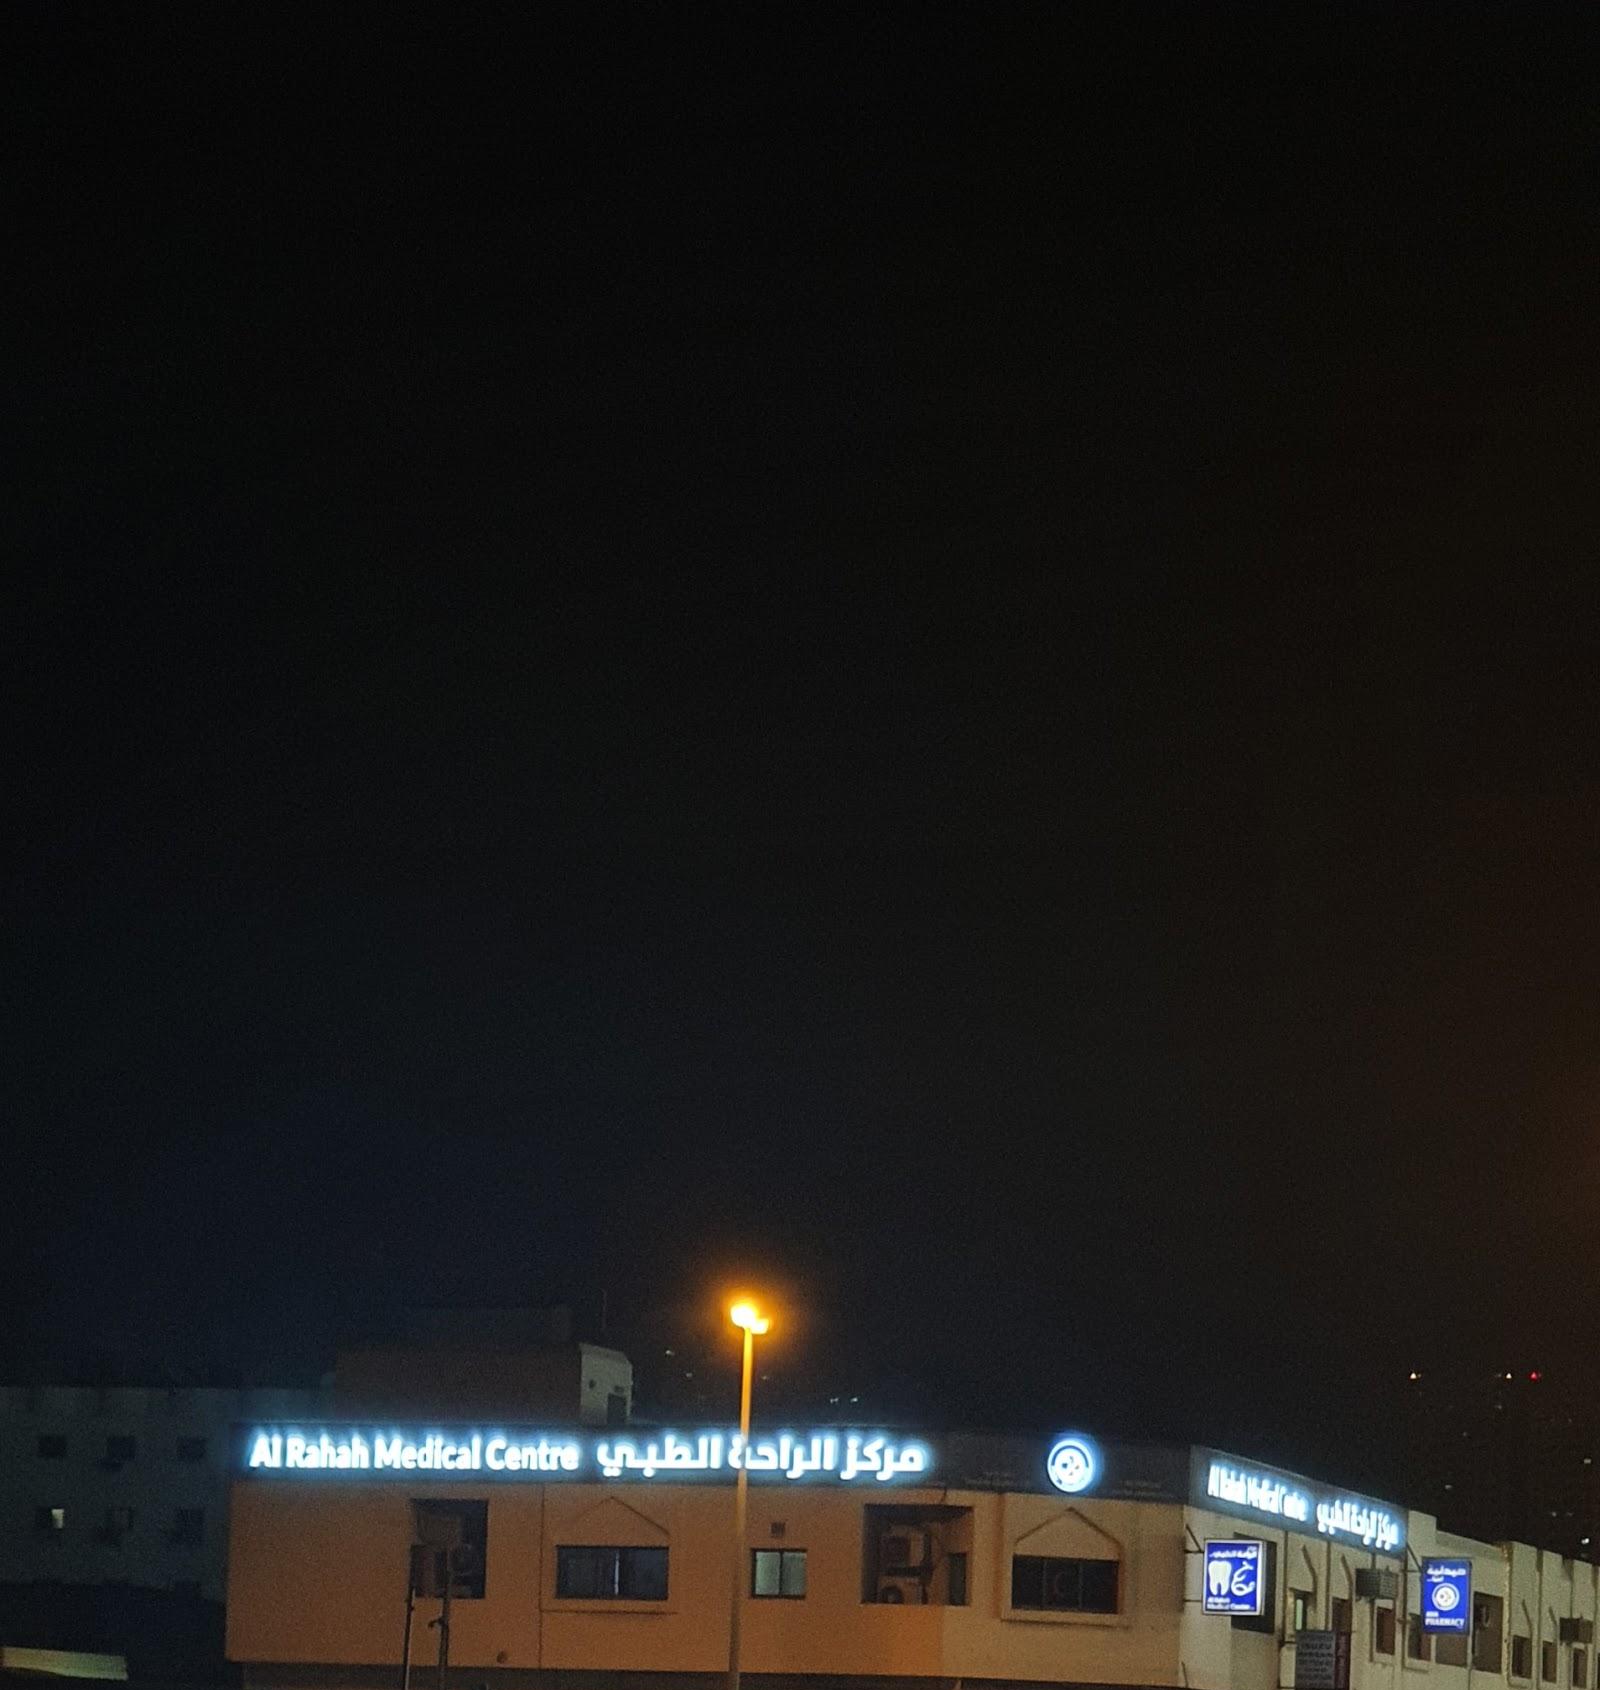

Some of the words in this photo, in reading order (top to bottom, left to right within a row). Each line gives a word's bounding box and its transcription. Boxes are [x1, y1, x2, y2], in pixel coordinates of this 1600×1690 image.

[250, 1435, 282, 1468] Al
[286, 1435, 370, 1469] Rahah
[374, 1434, 481, 1469] Medical
[485, 1437, 579, 1471] Centre
[597, 1434, 721, 1478] الطبي
[728, 1435, 834, 1480] الراحة
[840, 1436, 924, 1481] مركز
[1425, 1617, 1465, 1627] PHARMACY
